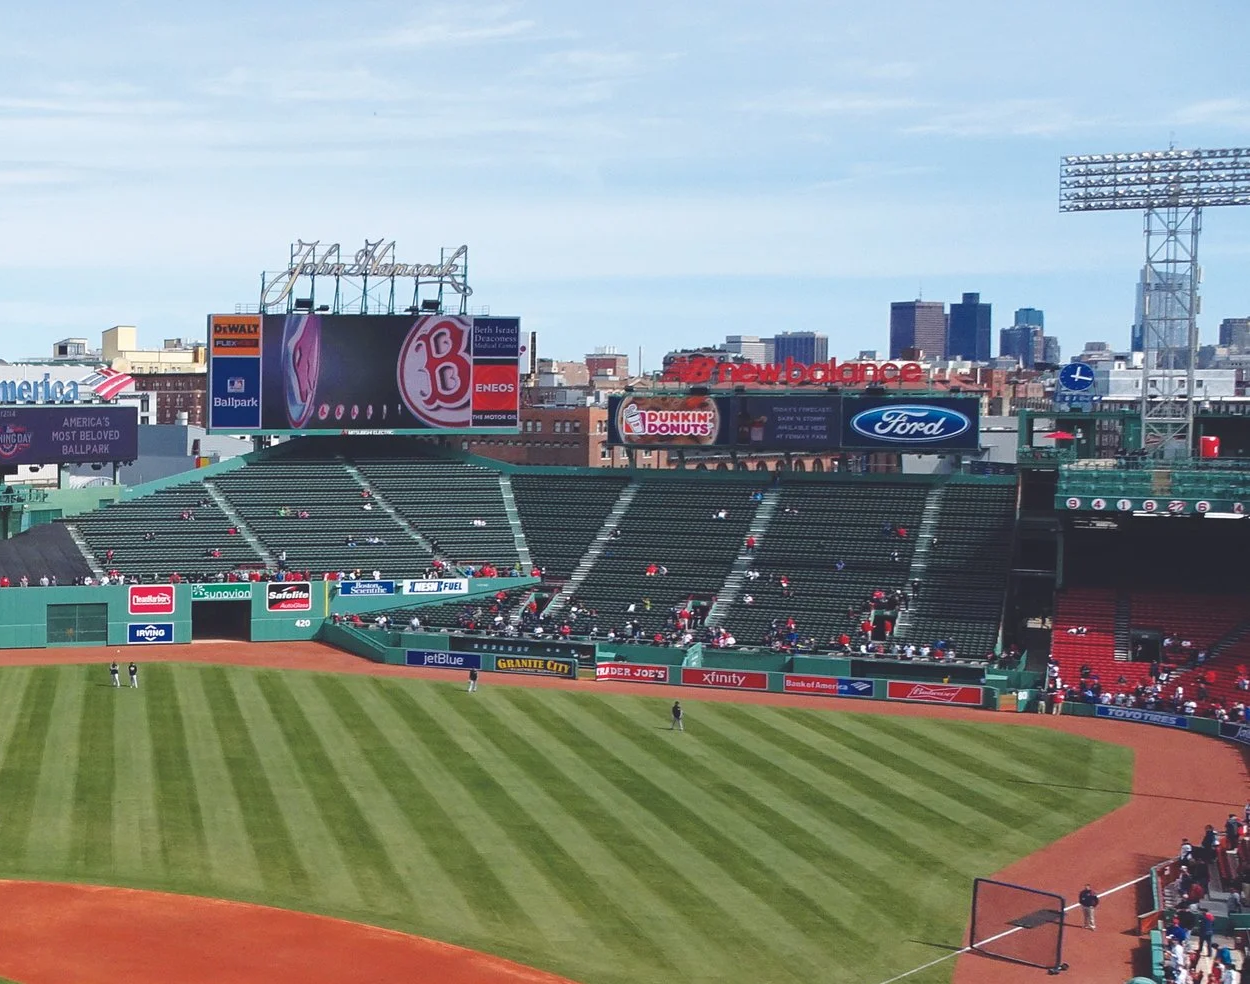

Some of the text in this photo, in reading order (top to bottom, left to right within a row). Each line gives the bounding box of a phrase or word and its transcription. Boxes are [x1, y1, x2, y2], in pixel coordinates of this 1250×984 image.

[261, 238, 473, 306] John Hancock
[718, 356, 922, 384] new balance
[475, 384, 514, 392] ENEOS
[214, 397, 258, 408] Ballpark
[62, 417, 110, 427] AMERICA'S
[647, 411, 713, 423] DUNKIN'
[874, 409, 947, 436] Ford
[647, 423, 709, 434] DONUTS
[17, 433, 32, 443] DAY
[52, 430, 120, 441] MOST BELOVED
[62, 444, 109, 455] BALLPARK
[204, 586, 250, 598] sunovion
[443, 582, 462, 591] FUEL
[268, 591, 309, 600] Safelite
[136, 629, 165, 638] IRVING
[423, 653, 463, 666] jetBlue
[497, 658, 544, 669] GRANITE
[547, 660, 571, 674] CITY
[596, 666, 666, 679] TRADER JOE'S
[702, 672, 746, 686] xfinity
[785, 679, 848, 691] Bank of America
[913, 687, 957, 699] Budweiser
[1107, 708, 1177, 725] TOYO TIRES
